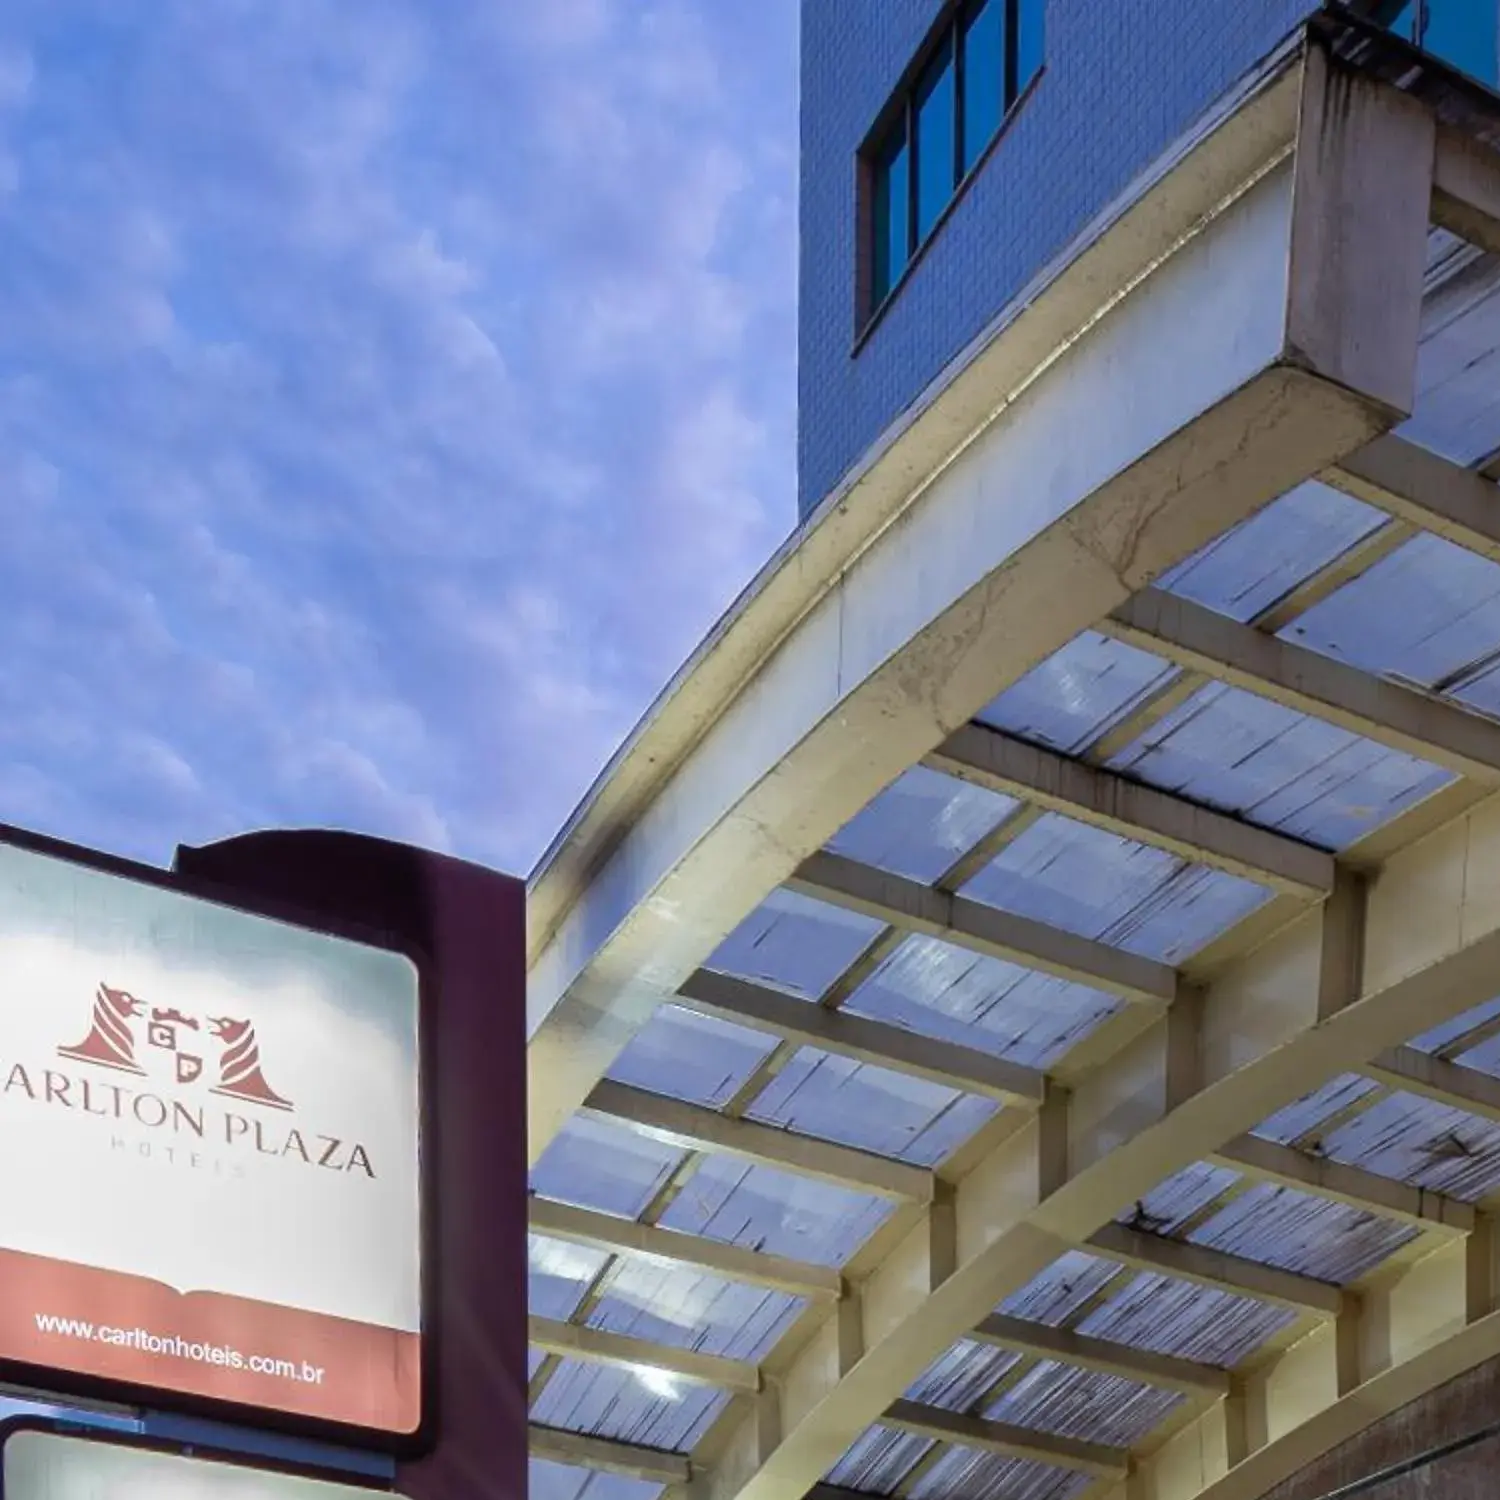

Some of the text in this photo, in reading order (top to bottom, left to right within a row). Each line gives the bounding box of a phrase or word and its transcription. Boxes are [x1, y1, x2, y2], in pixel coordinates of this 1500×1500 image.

[2, 1062, 377, 1179] ARLTON PLAZA
[35, 1312, 325, 1384] www.carltonhoteis.com.br
